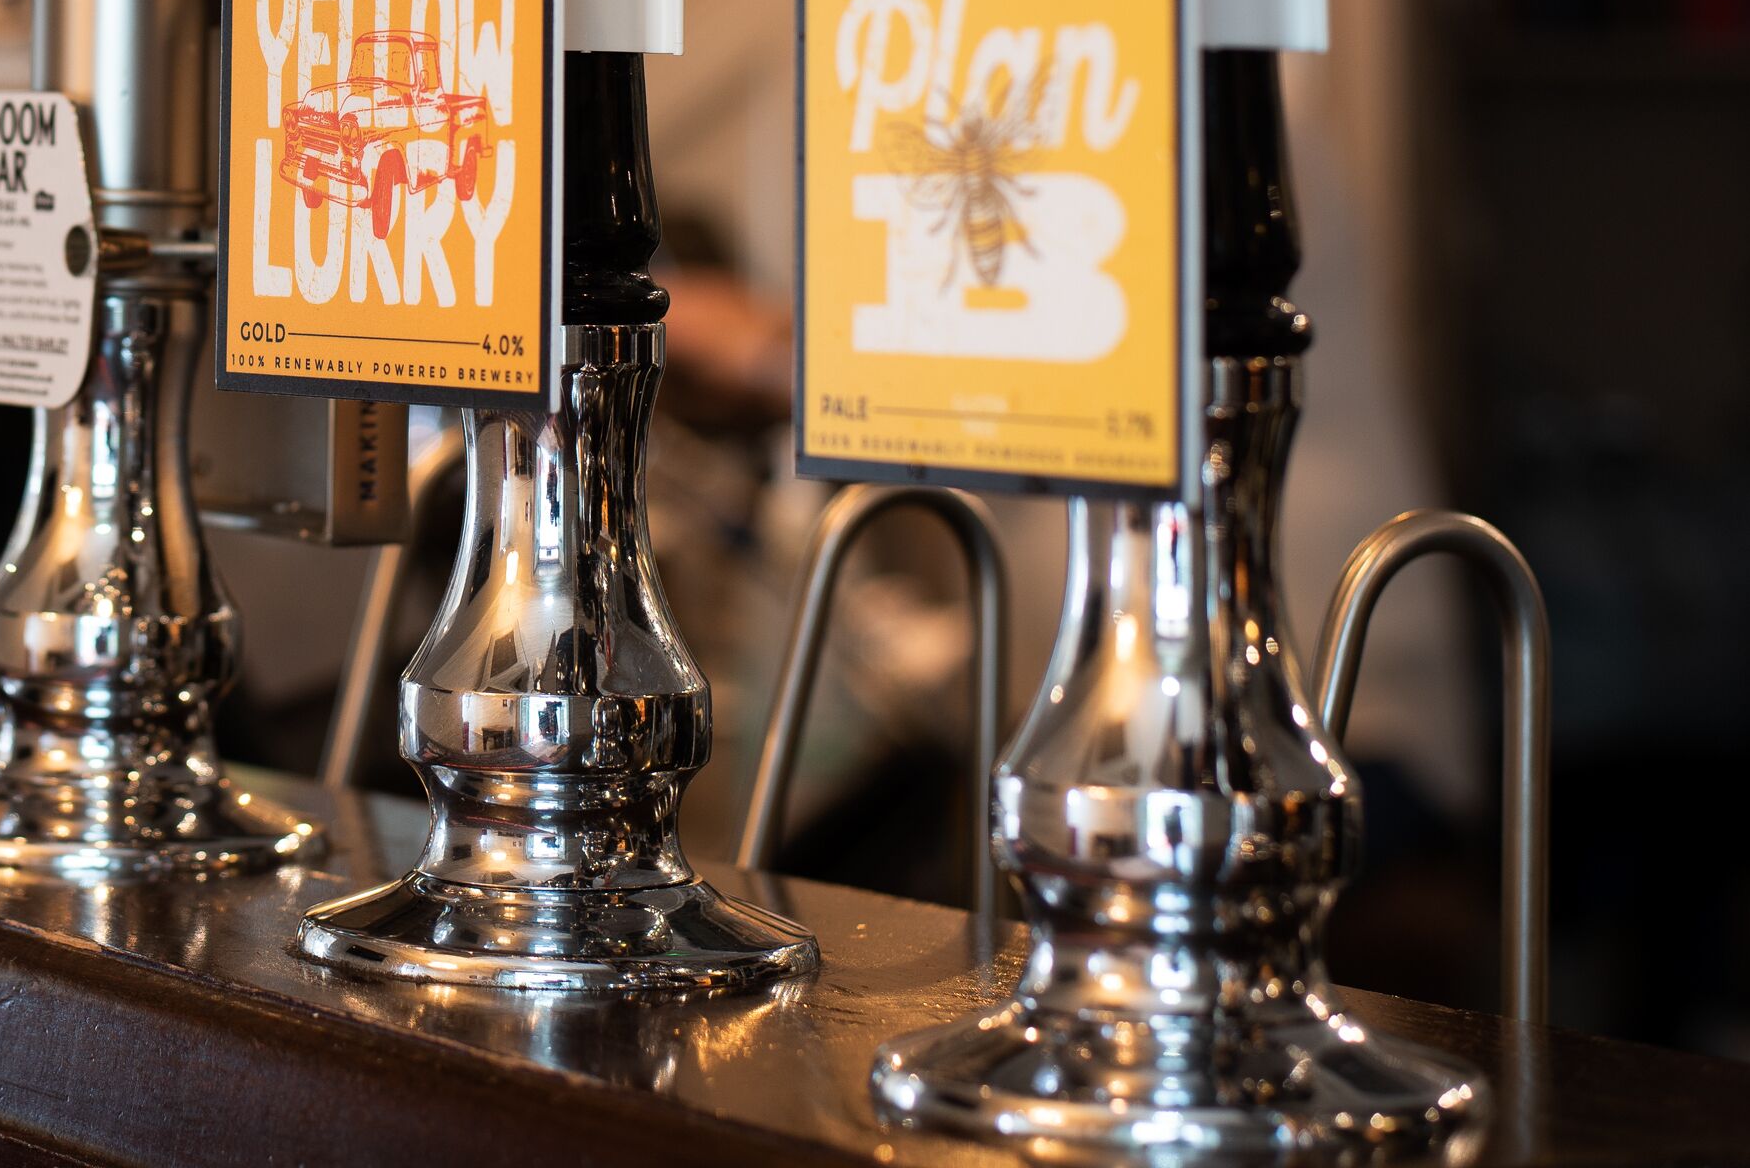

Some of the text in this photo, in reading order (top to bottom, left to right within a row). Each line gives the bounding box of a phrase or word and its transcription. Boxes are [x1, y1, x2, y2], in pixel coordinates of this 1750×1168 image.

[252, 138, 517, 308] LORRY
[851, 171, 1129, 363] B
[230, 352, 536, 385] 100% RENEWABLY POWERED BREWERY
[240, 321, 525, 357] GOLD 4.0%
